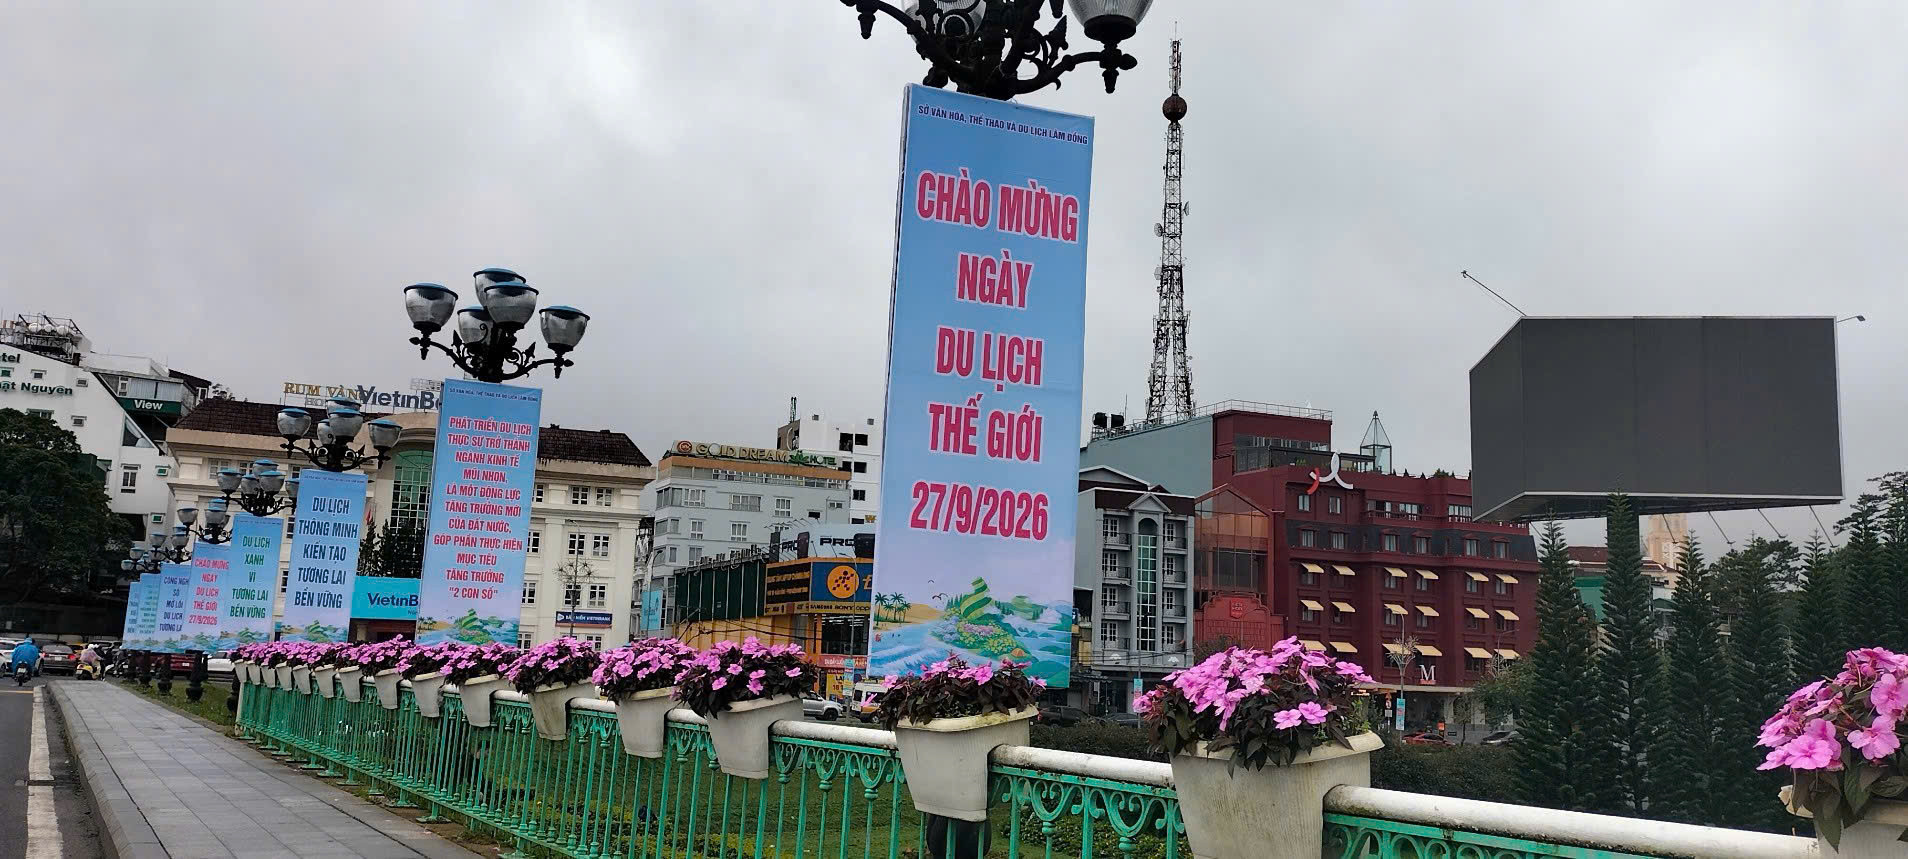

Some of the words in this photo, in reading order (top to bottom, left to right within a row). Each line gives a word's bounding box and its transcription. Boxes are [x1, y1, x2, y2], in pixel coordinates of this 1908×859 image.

[985, 117, 1004, 129] THAO
[1018, 124, 1029, 134] DU
[916, 168, 992, 228] CHÀO
[998, 180, 1079, 242] MỪNG
[957, 250, 1033, 308] NGÀY
[0, 353, 20, 363] tel
[936, 327, 975, 377] DU
[981, 333, 1043, 392] LỊCH
[284, 382, 321, 396] RUM
[134, 400, 163, 410] View
[450, 416, 471, 429] PHÁT
[474, 417, 497, 432] TRIỂN
[500, 422, 511, 432] DU
[513, 424, 532, 437] LỊCH
[928, 393, 983, 456] THẾ
[987, 404, 1043, 462] GIỚI
[448, 434, 469, 447] THỰC
[471, 436, 484, 448] SỰ
[504, 438, 530, 451] THÀNH
[456, 450, 485, 464] NGÀNH
[487, 454, 507, 465] KINH
[510, 453, 521, 467] TẾ
[696, 442, 736, 457] GOLD
[739, 447, 789, 463] DREAM
[810, 454, 837, 465] HOTEL
[446, 482, 456, 494] LÀ
[480, 486, 504, 500] ĐỘNG
[505, 490, 520, 502] LỰC
[312, 497, 326, 512] DU
[328, 498, 350, 516] LỊCH
[505, 505, 522, 516] MỚI
[910, 481, 1049, 541] 27/9/2026
[298, 517, 330, 537] THÔNG
[332, 522, 358, 538] MINH
[448, 516, 466, 530] CỦA
[242, 536, 252, 547] DU
[254, 536, 270, 550] LỊCH
[434, 534, 452, 545] GÓP
[480, 537, 500, 551] THỰC
[502, 538, 522, 552] HIỆN
[244, 553, 264, 566] XANH
[302, 540, 326, 560] KIẾN
[329, 545, 347, 564] TẠO
[456, 553, 476, 566] MỤC
[479, 553, 497, 566] TIÊU
[178, 578, 189, 586] NGH
[298, 566, 330, 584] TƯƠNG
[331, 569, 346, 586] LAI
[196, 586, 205, 596] DU
[232, 588, 256, 600] TƯƠNG
[257, 590, 268, 601] LAI
[294, 587, 314, 607] BỀN
[317, 590, 343, 609] VỮNG
[367, 592, 419, 607] VietinB
[462, 588, 480, 599] CON
